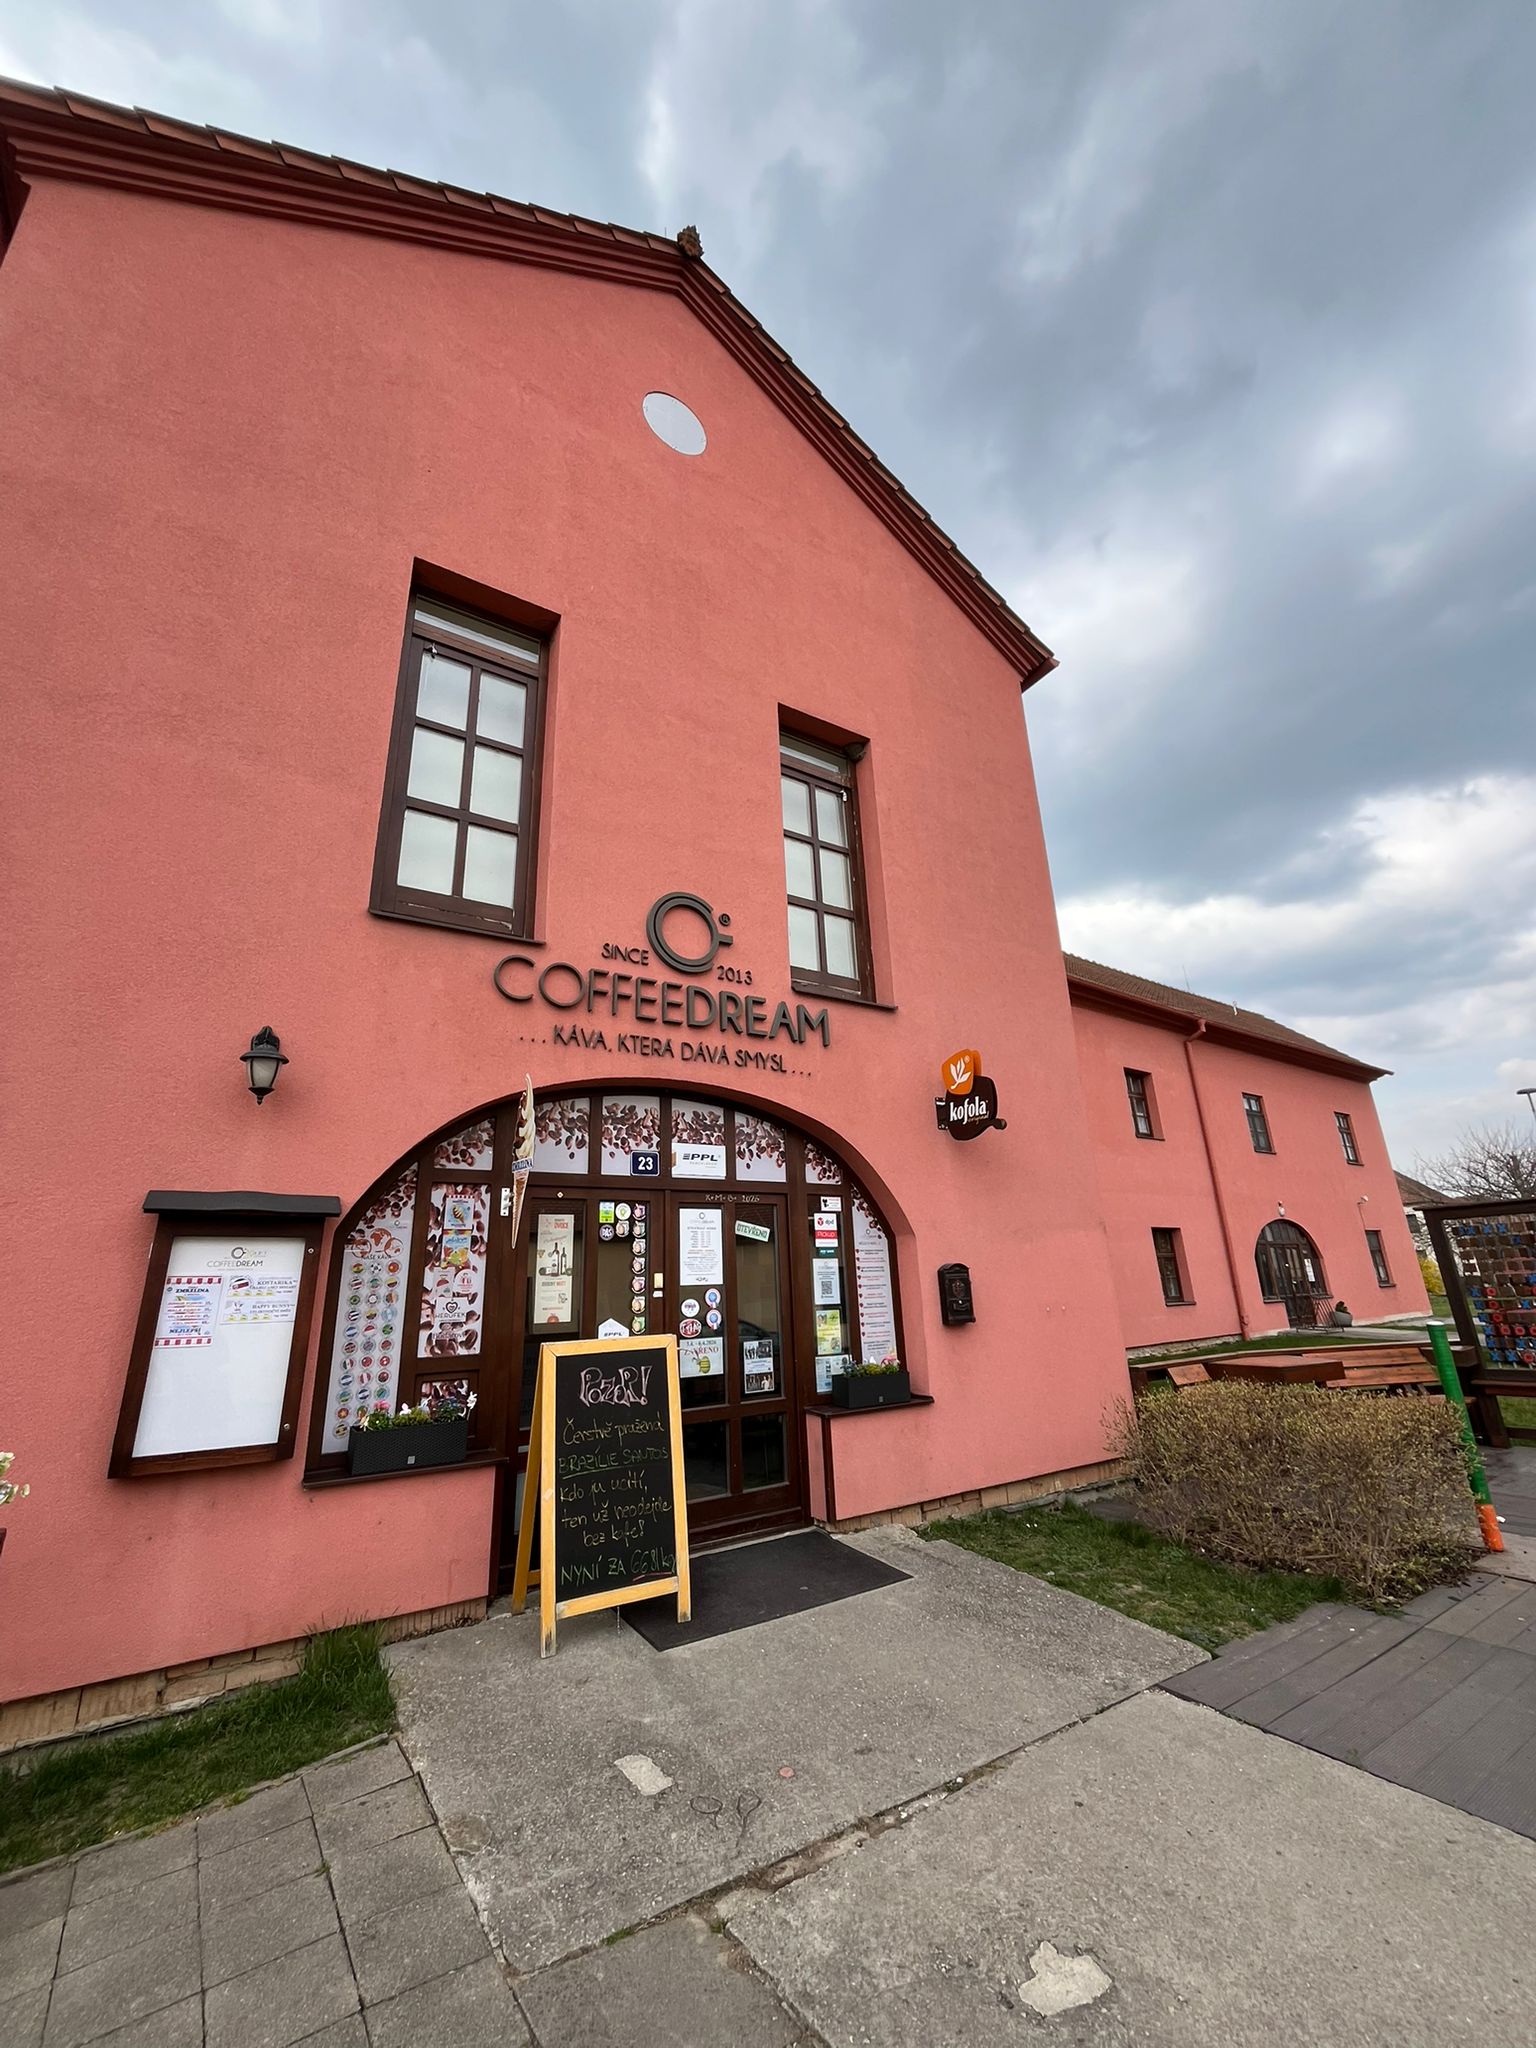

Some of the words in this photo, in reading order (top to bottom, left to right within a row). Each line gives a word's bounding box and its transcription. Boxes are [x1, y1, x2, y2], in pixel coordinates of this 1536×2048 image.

[601, 943, 649, 966] SINCE
[716, 965, 753, 986] 2013
[493, 954, 831, 1048] COFFEEDREAM
[617, 1033, 675, 1058] KTERÁ
[681, 1042, 730, 1065] DÁVÁ
[734, 1049, 787, 1073] SMYSL
[949, 1096, 988, 1125] kofola
[638, 1156, 654, 1171] 23
[736, 1223, 768, 1239] OTEVŘENO
[563, 1417, 613, 1445] Čerstvě
[561, 1508, 587, 1528] ten
[592, 1499, 610, 1523] už
[583, 1530, 606, 1547] bez
[561, 1555, 602, 1588] NYNÍ
[608, 1557, 626, 1576] ZA
